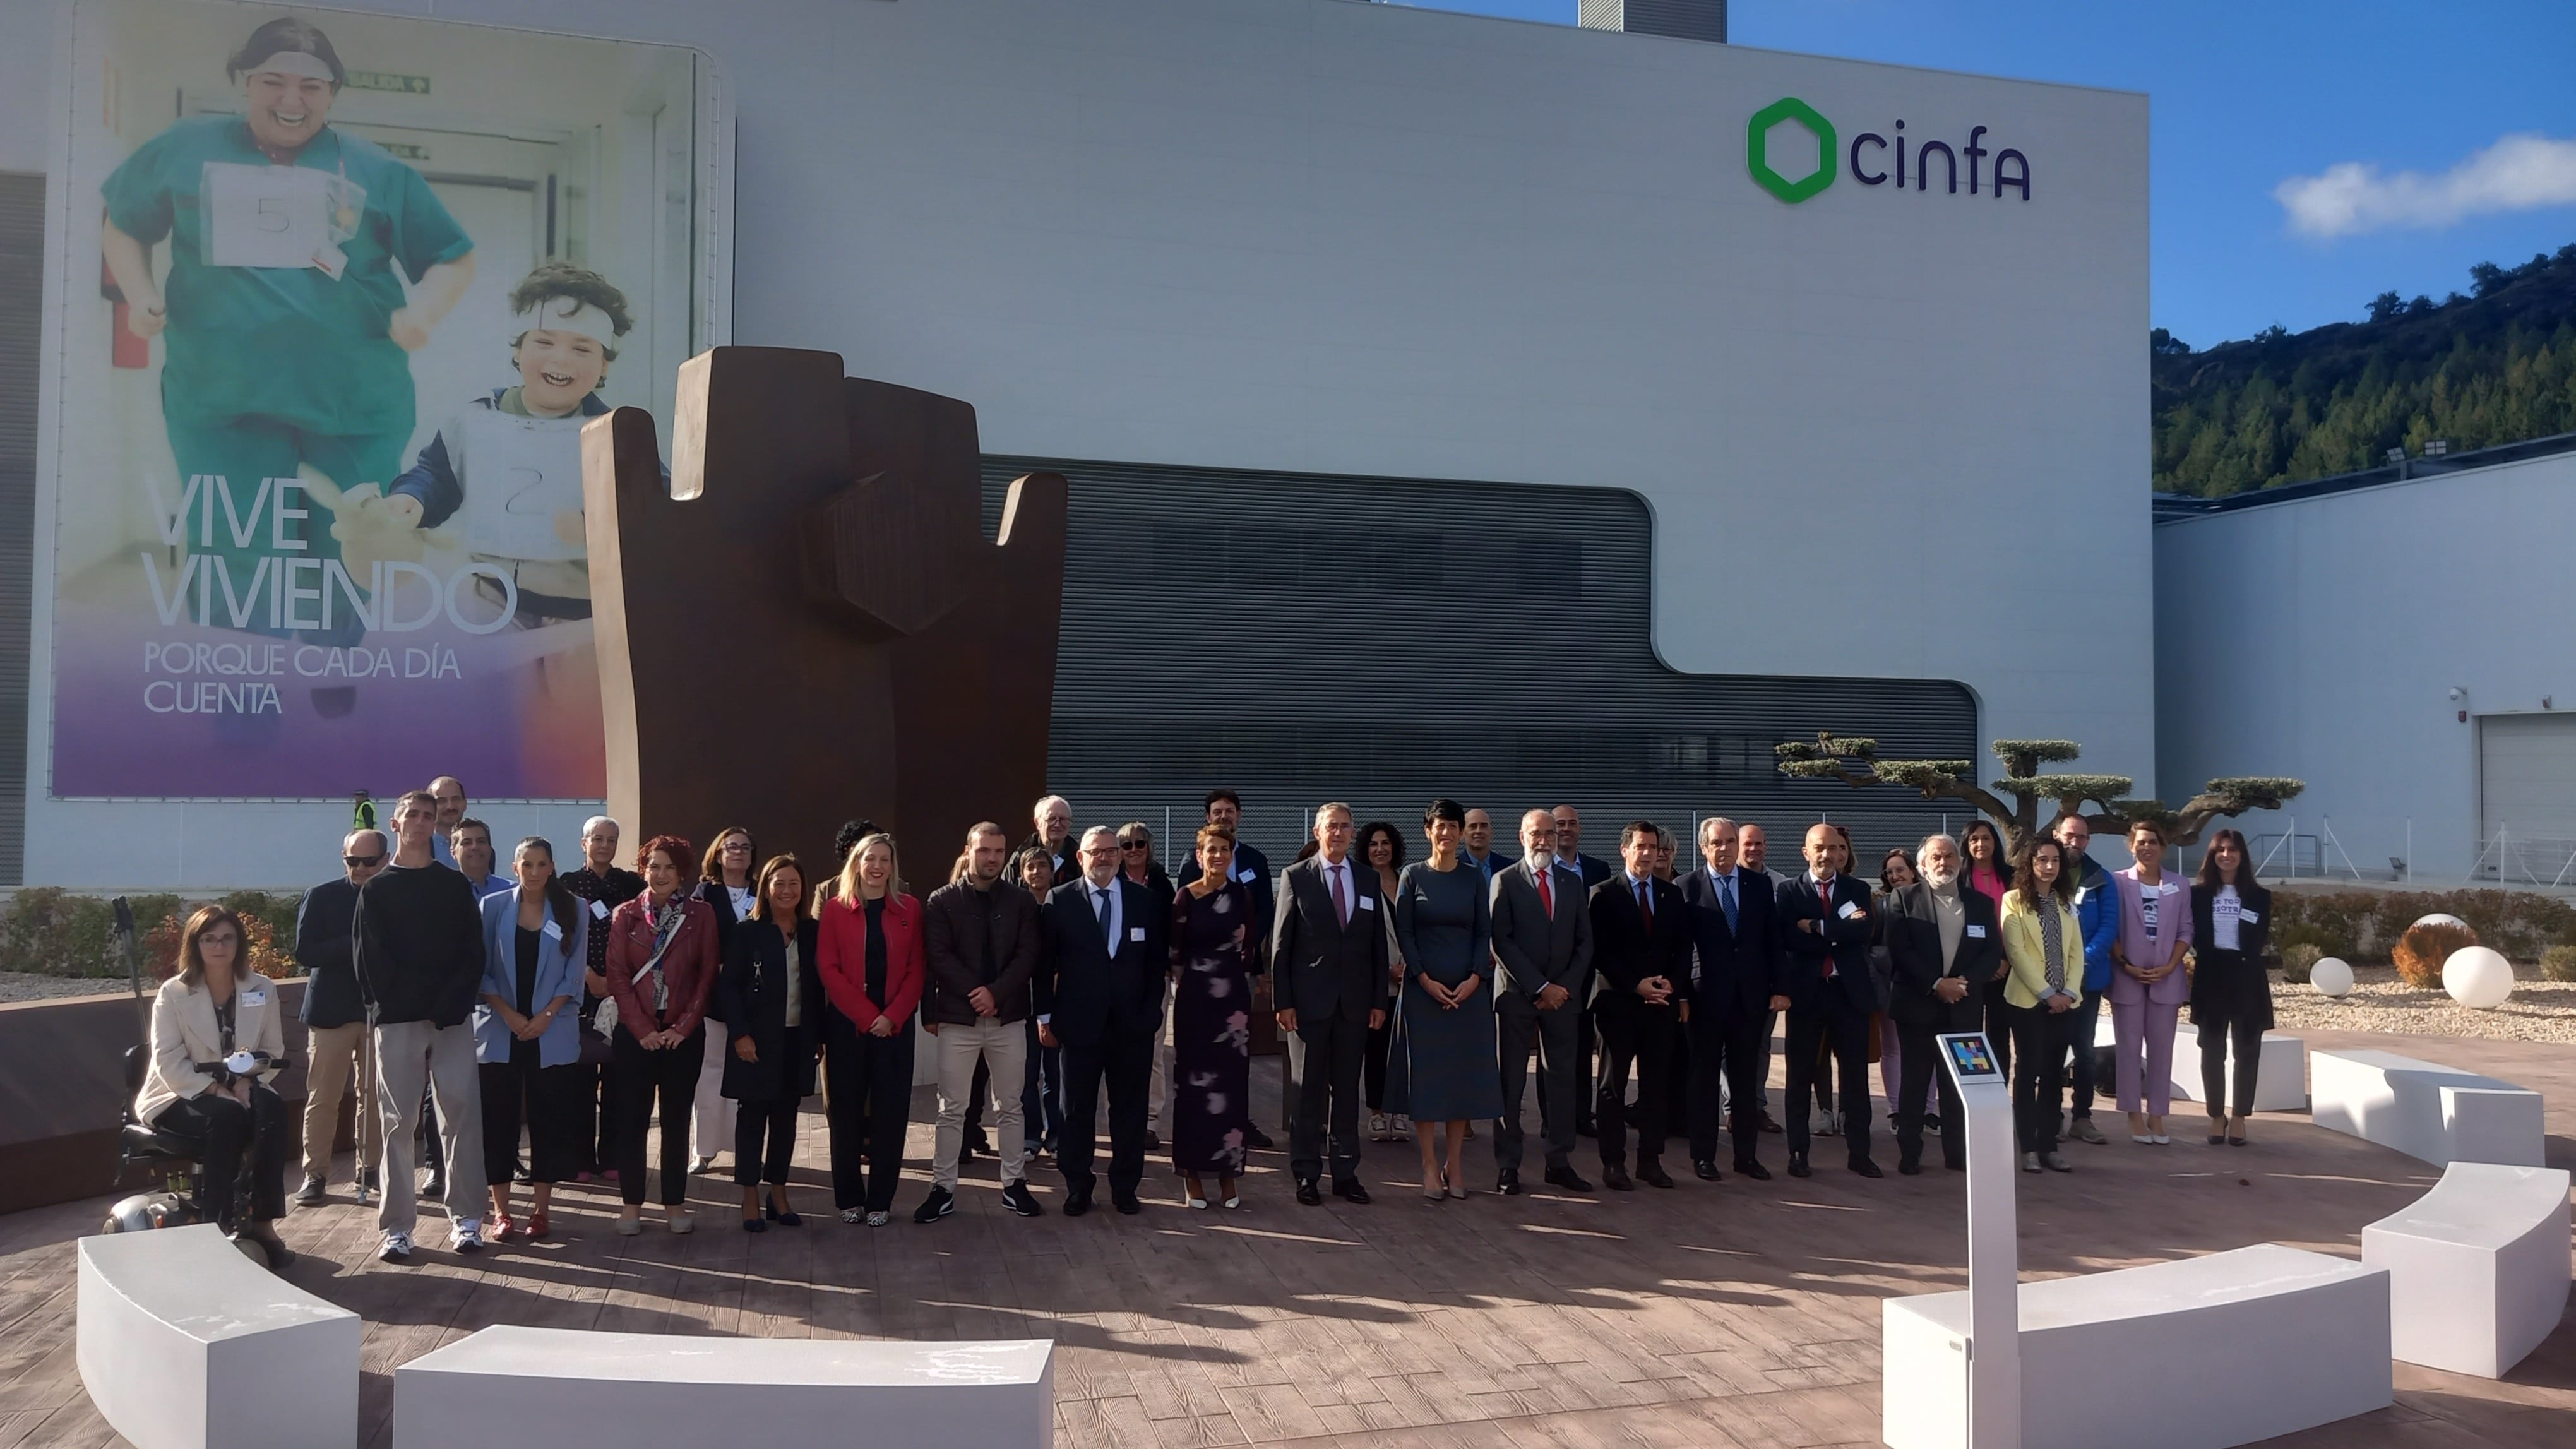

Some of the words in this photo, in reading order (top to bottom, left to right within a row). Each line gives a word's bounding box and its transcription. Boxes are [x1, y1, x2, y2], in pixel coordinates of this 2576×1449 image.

[258, 198, 289, 232] 5
[145, 474, 308, 550] VIVE
[506, 468, 545, 515] 2
[141, 552, 517, 635] VIVIENDO
[145, 641, 284, 675] PORQUE
[294, 645, 396, 678] CADA
[405, 642, 462, 679] DÍA
[144, 681, 282, 713] CUENTA
